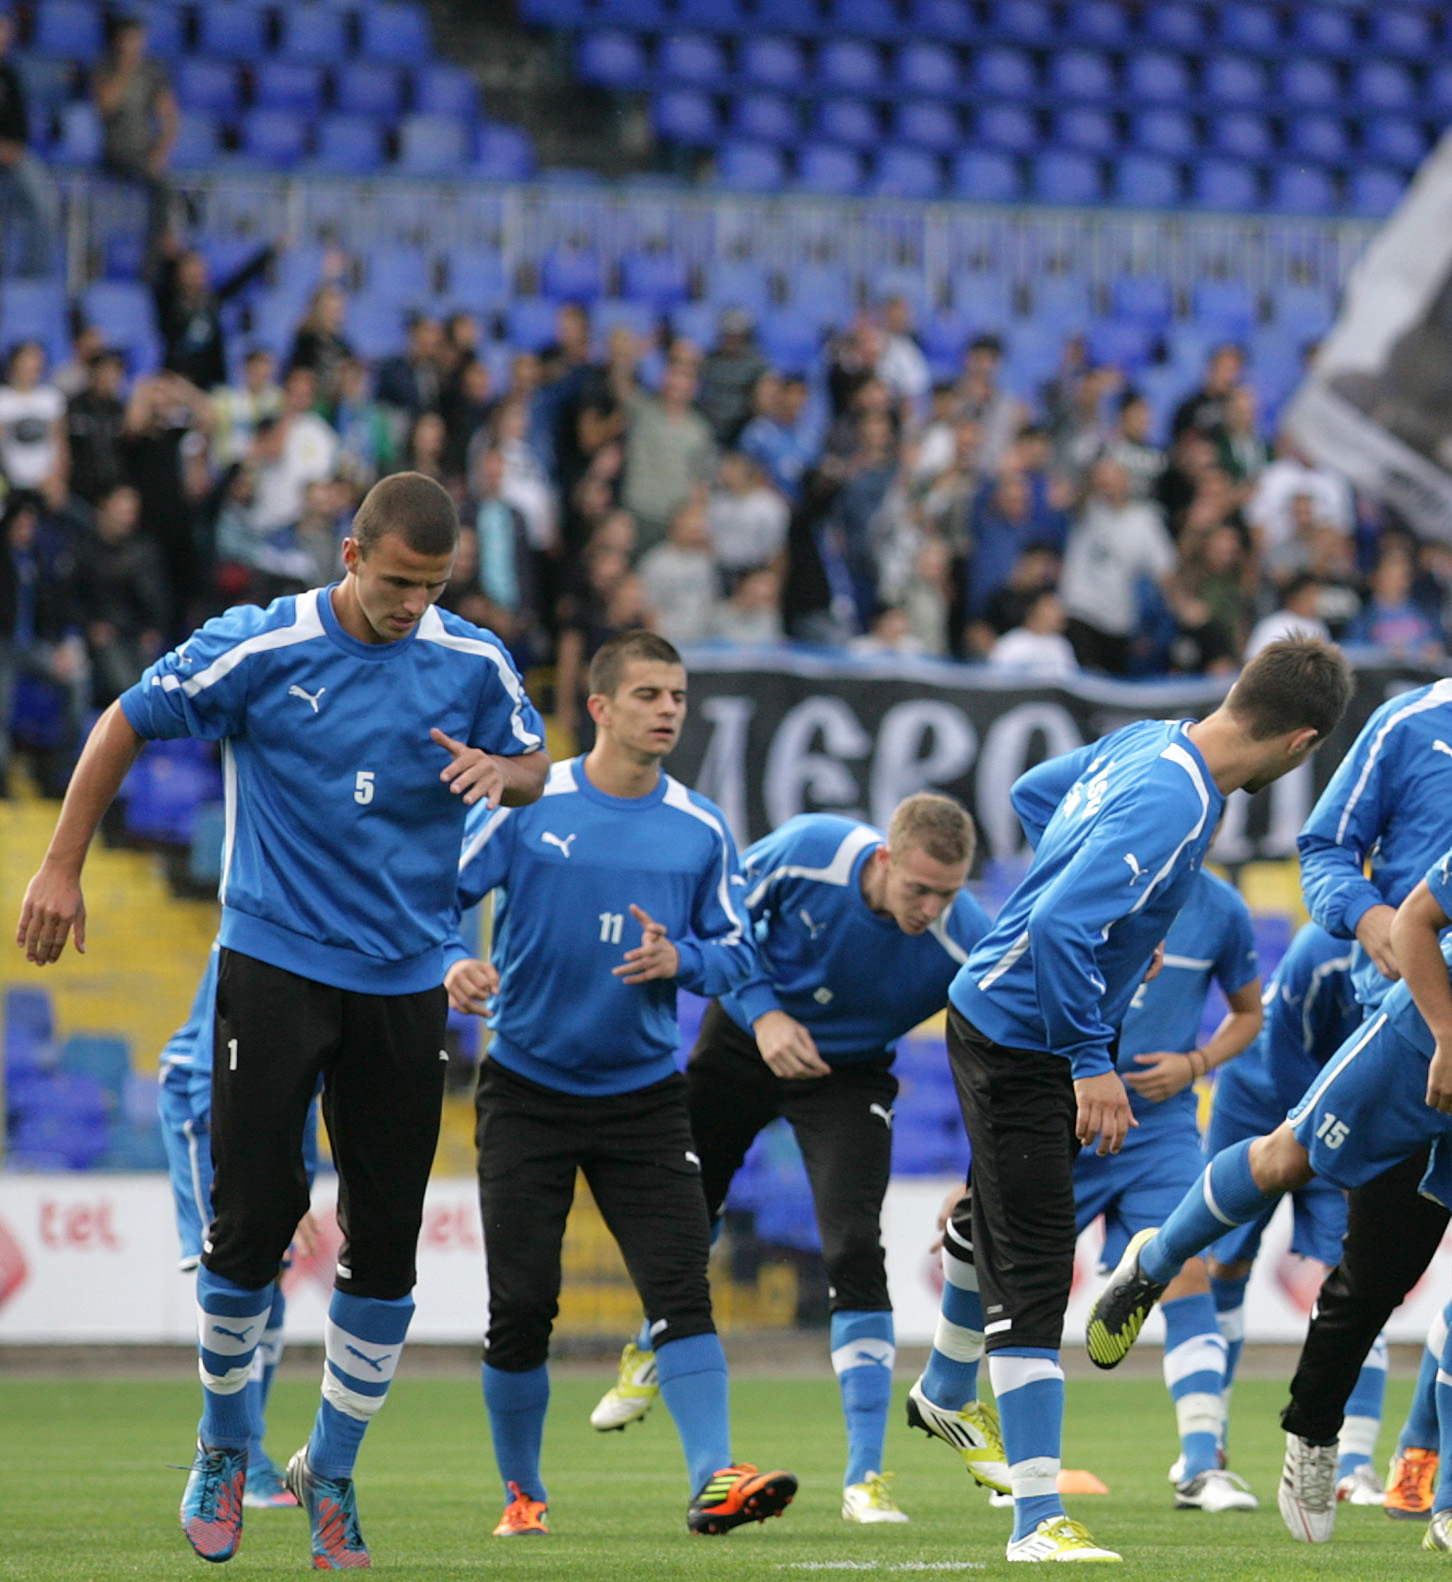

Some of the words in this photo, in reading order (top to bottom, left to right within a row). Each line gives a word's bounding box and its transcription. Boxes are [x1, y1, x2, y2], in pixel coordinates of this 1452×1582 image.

[353, 770, 376, 805] 5
[598, 911, 624, 944] 11
[1315, 1111, 1351, 1150] 15
